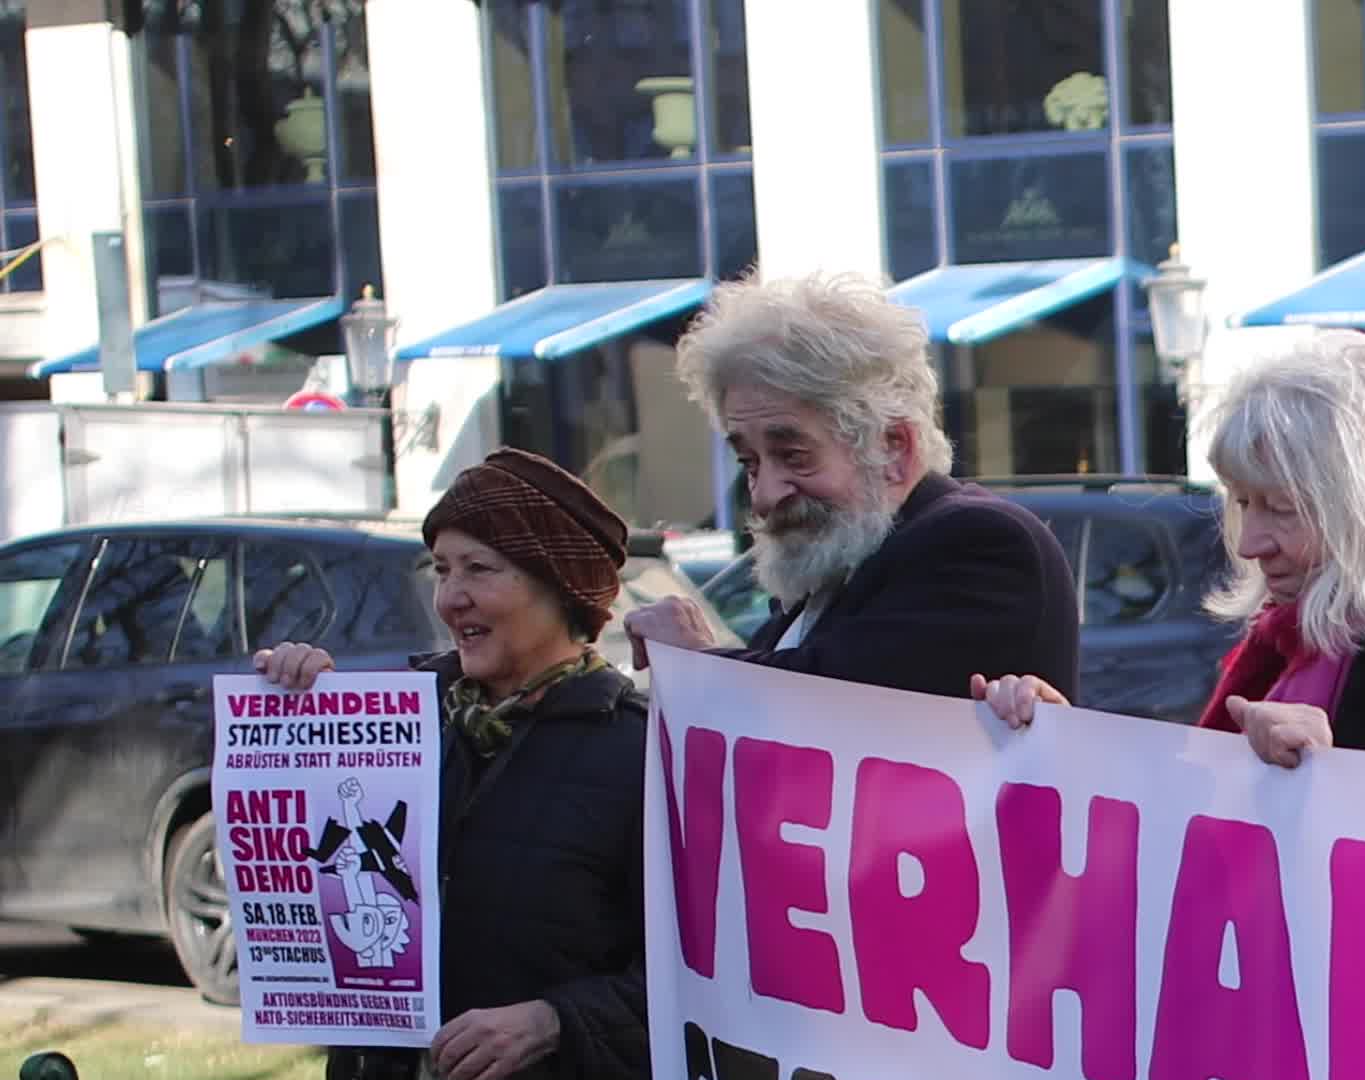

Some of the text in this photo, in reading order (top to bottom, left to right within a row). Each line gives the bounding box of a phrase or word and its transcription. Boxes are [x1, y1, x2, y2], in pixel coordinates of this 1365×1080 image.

[227, 691, 421, 717] VERHANDELN
[228, 721, 422, 747] STATT SCHIESSEN!
[226, 748, 422, 769] ABRÜSTEN STATT AUFRÜSTEN
[227, 789, 307, 824] ANTI
[229, 827, 311, 862] SIKO
[235, 864, 314, 894] DEMO
[262, 990, 359, 1010] AKTIONSBÜNDNIS
